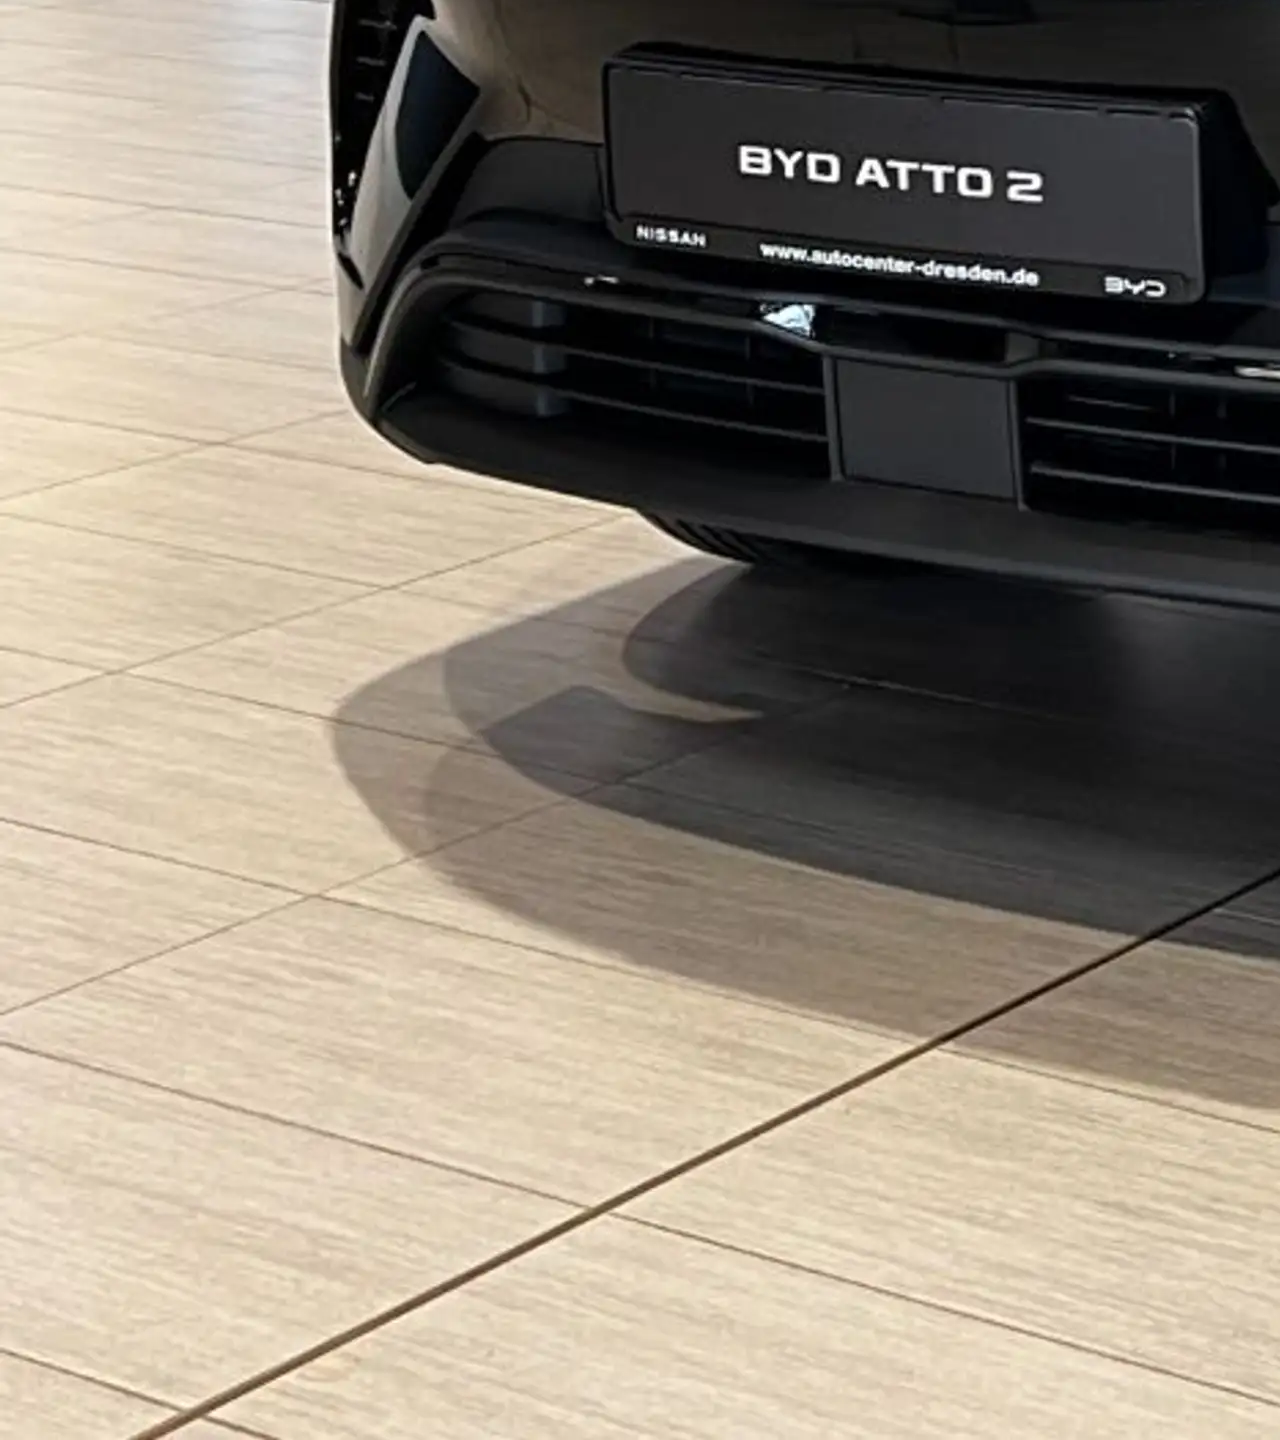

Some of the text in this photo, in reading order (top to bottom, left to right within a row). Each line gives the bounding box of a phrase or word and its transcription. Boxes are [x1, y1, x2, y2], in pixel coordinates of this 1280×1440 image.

[738, 144, 1045, 203] BYD ATTO 2
[636, 224, 706, 248] NISSAN
[759, 242, 1039, 287] www.autocenter-dresden.de
[1104, 276, 1167, 298] BYD
